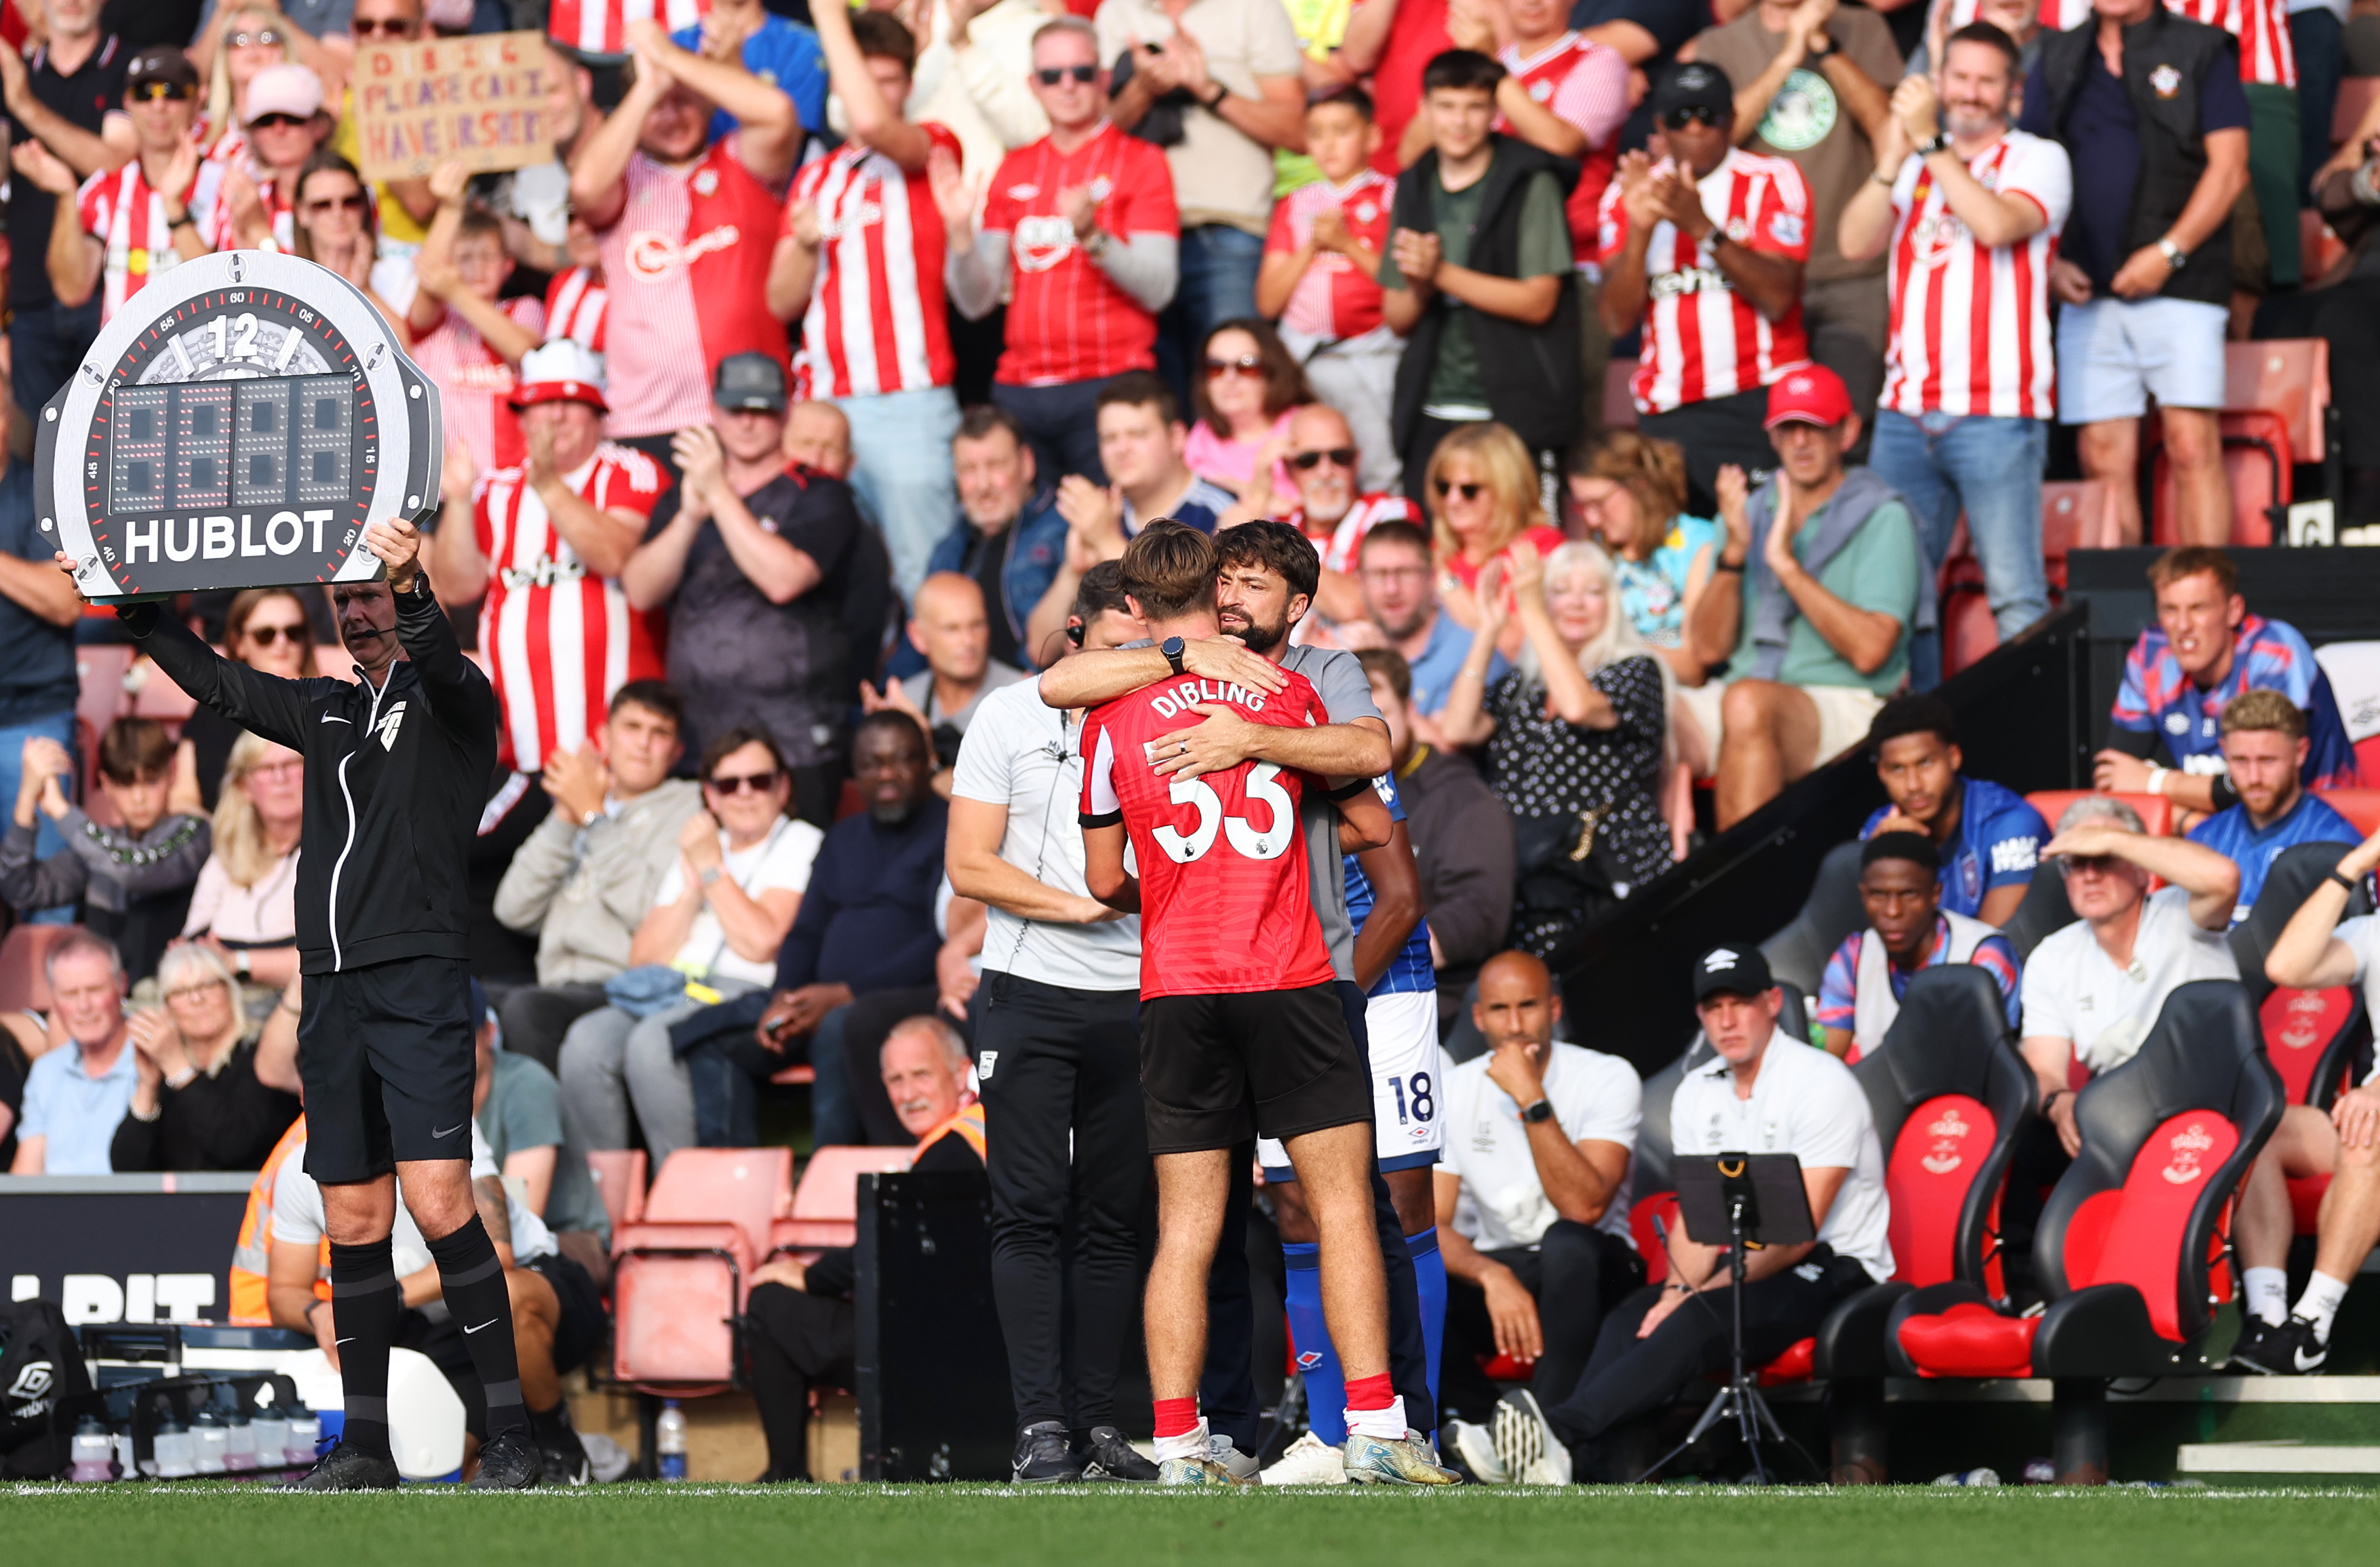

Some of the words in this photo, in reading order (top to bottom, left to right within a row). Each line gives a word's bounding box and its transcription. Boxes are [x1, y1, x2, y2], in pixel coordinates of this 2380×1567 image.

[365, 72, 462, 115] PLEASE
[367, 118, 440, 164] HAVE
[229, 292, 245, 304] 60
[159, 316, 176, 333] 55
[298, 308, 313, 323] 05
[208, 313, 258, 359] 12
[87, 461, 98, 479] 45
[366, 446, 376, 464] 15
[125, 509, 334, 563] HUBLOT
[343, 528, 357, 548] 20
[102, 544, 117, 563] 40
[1150, 679, 1267, 719] DIBLING
[1143, 740, 1295, 864] 33
[1388, 1071, 1434, 1125] 18
